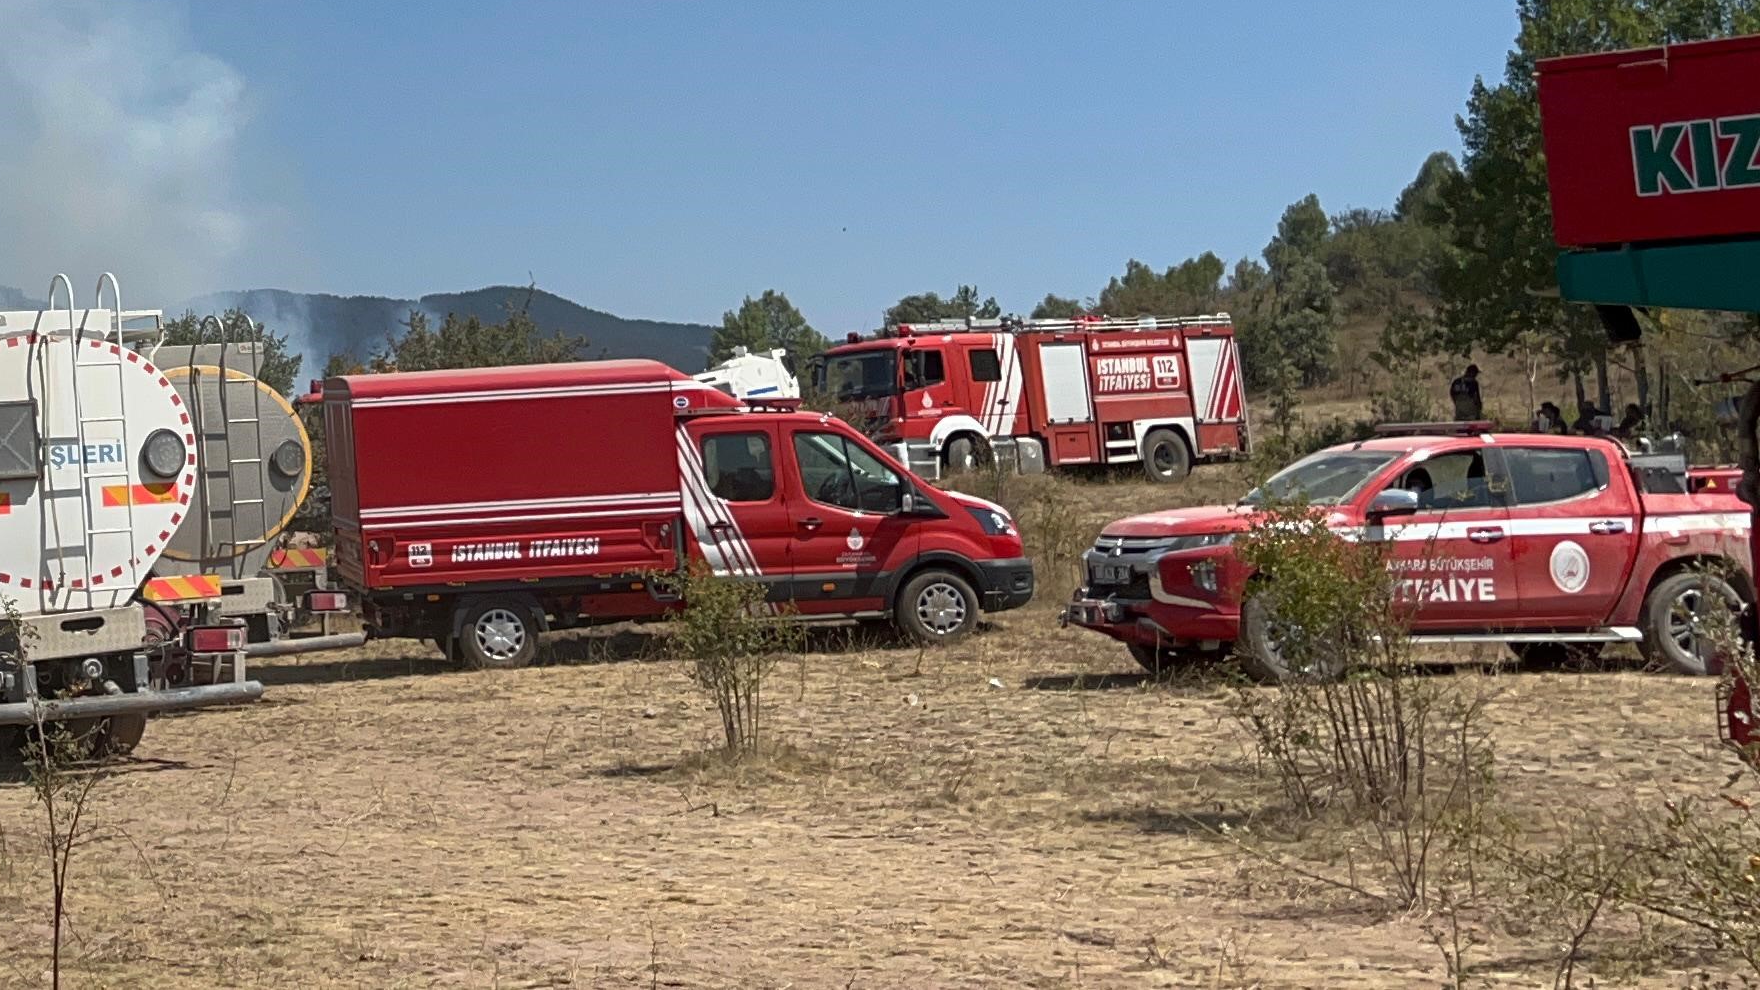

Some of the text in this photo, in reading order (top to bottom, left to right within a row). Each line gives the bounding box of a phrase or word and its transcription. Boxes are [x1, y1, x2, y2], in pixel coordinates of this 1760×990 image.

[1629, 114, 1760, 197] KIZ
[1157, 359, 1174, 373] 112
[1099, 374, 1151, 391] İTFAİYESİ
[1391, 573, 1496, 602] TFAİYE
